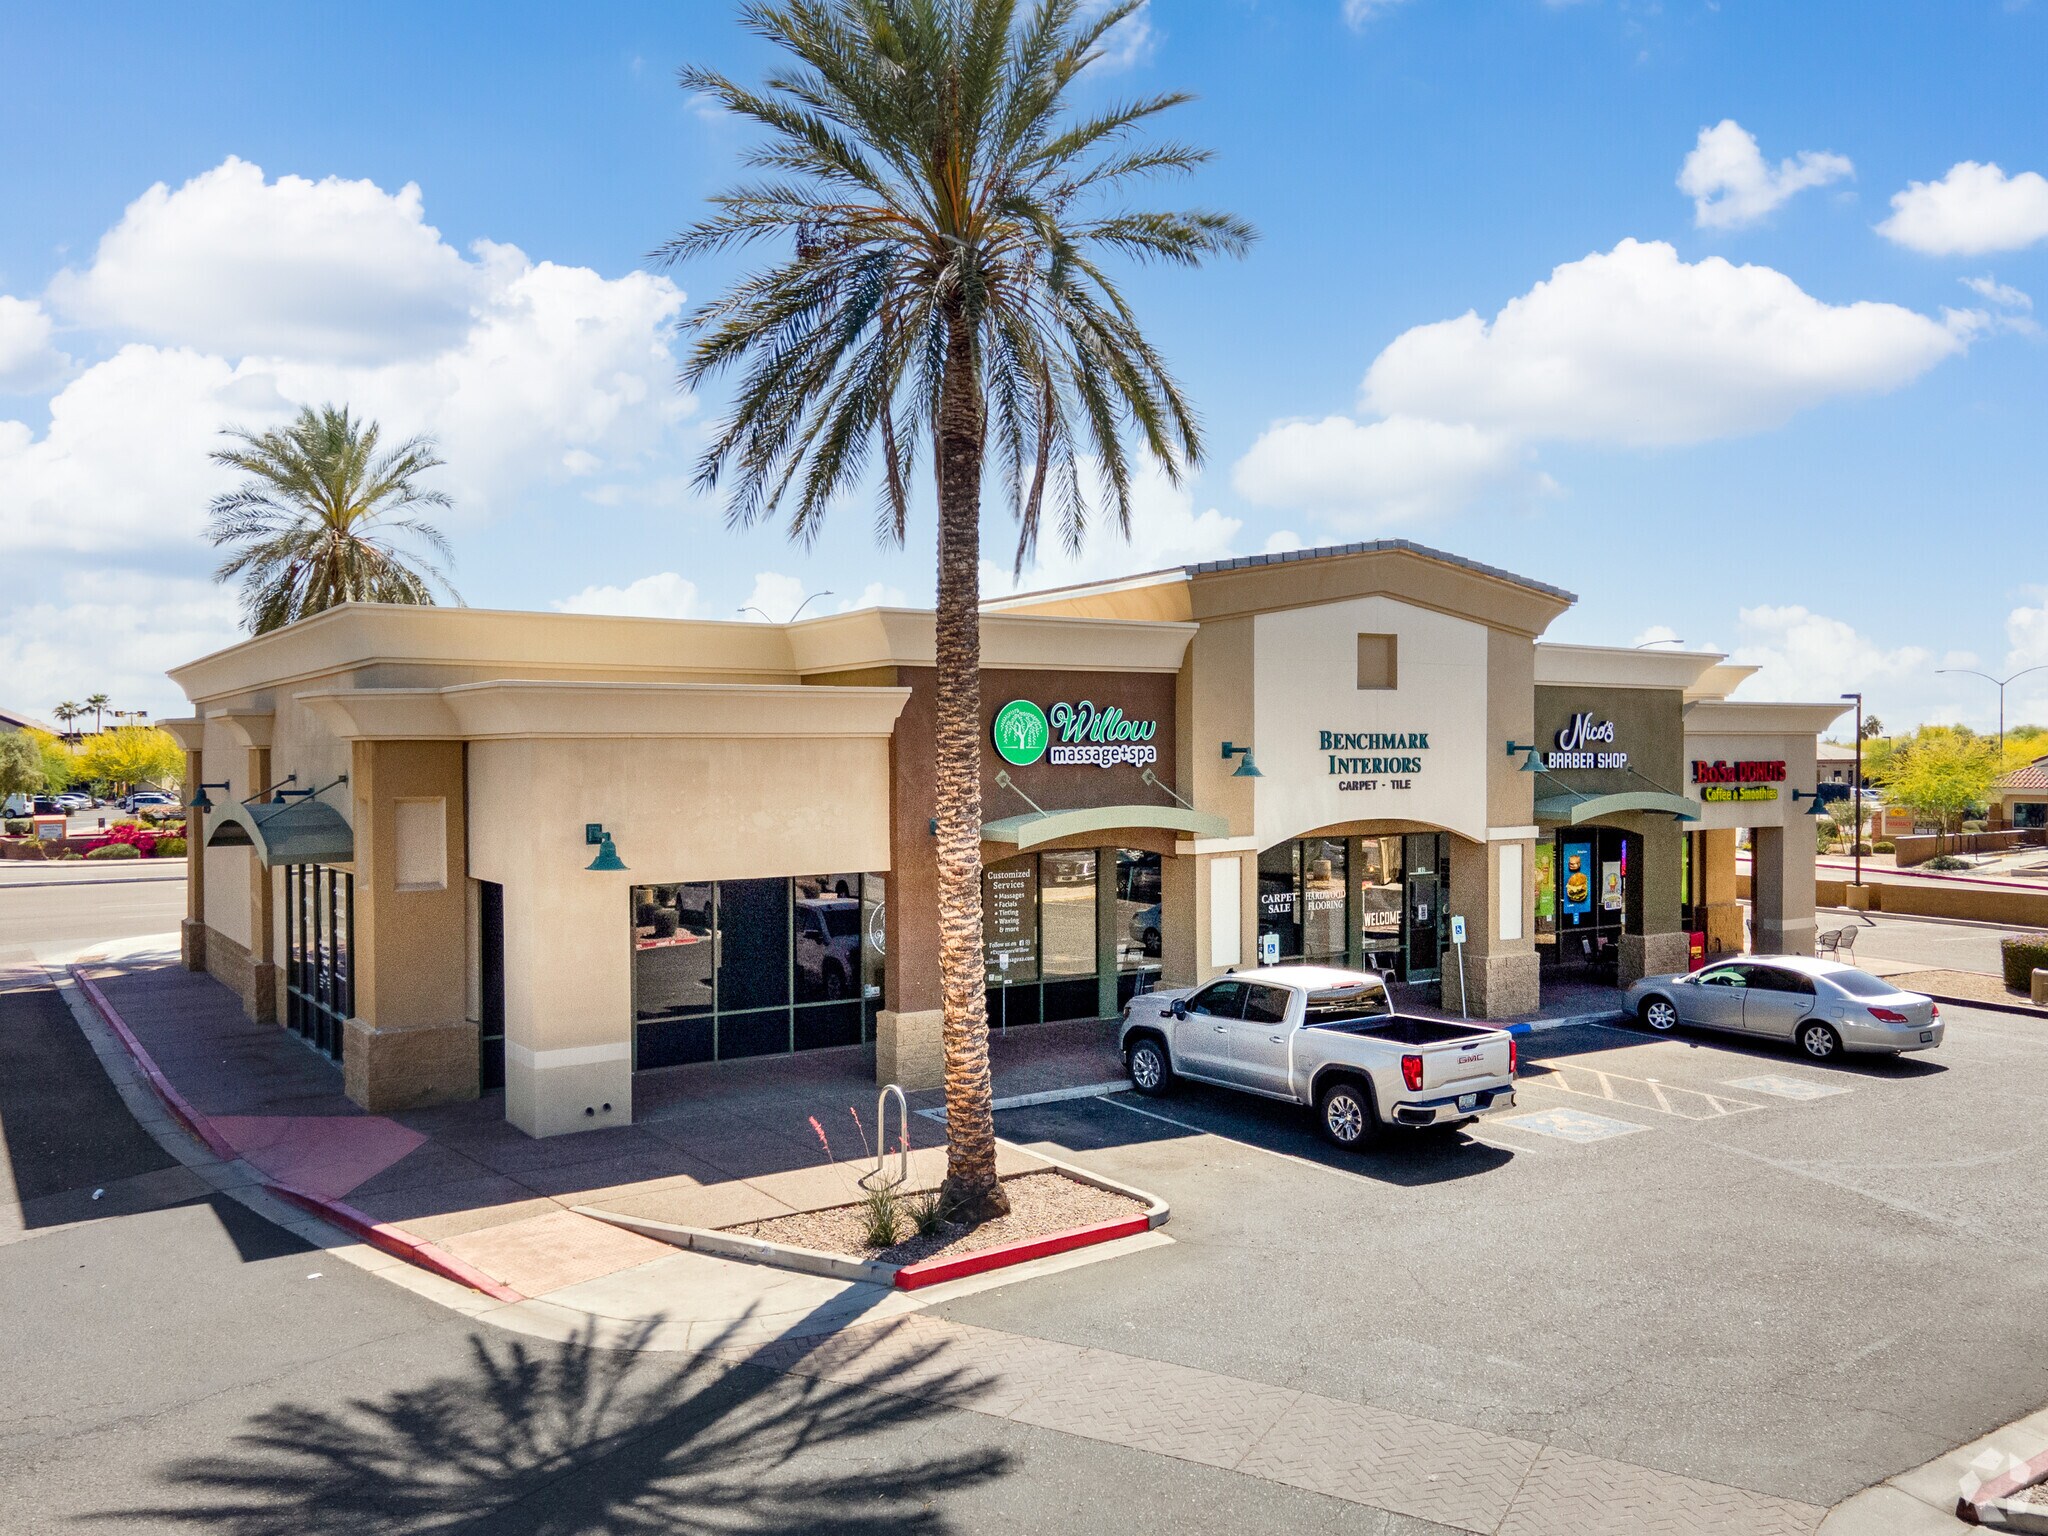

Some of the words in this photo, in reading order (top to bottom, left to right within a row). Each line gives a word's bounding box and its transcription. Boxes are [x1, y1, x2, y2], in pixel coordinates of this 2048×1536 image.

[1050, 700, 1157, 744] Willow
[1560, 712, 1614, 751] Nico's
[1319, 730, 1430, 750] BENCHMARK
[1053, 746, 1156, 766] massage+spa
[1548, 752, 1594, 769] BARBER
[1597, 752, 1627, 769] SHOP
[1328, 755, 1422, 775] INTERIORS
[1697, 761, 1736, 782] BoSa
[1738, 761, 1786, 781] DONUTS
[1339, 780, 1377, 791] CARPET
[1391, 780, 1412, 790] TILE
[1706, 787, 1732, 800] Coffee
[1739, 786, 1778, 800] Smoothies
[988, 869, 1030, 880] Customized
[993, 880, 1024, 889] Services
[999, 892, 1024, 900] Massages
[1261, 892, 1297, 904] CARPET
[1305, 890, 1346, 900] HARDWOOD
[1268, 903, 1291, 914] SALE
[1308, 900, 1343, 910] FLOORING
[1364, 910, 1402, 927] WELCOME
[1457, 1054, 1484, 1064] GMC
